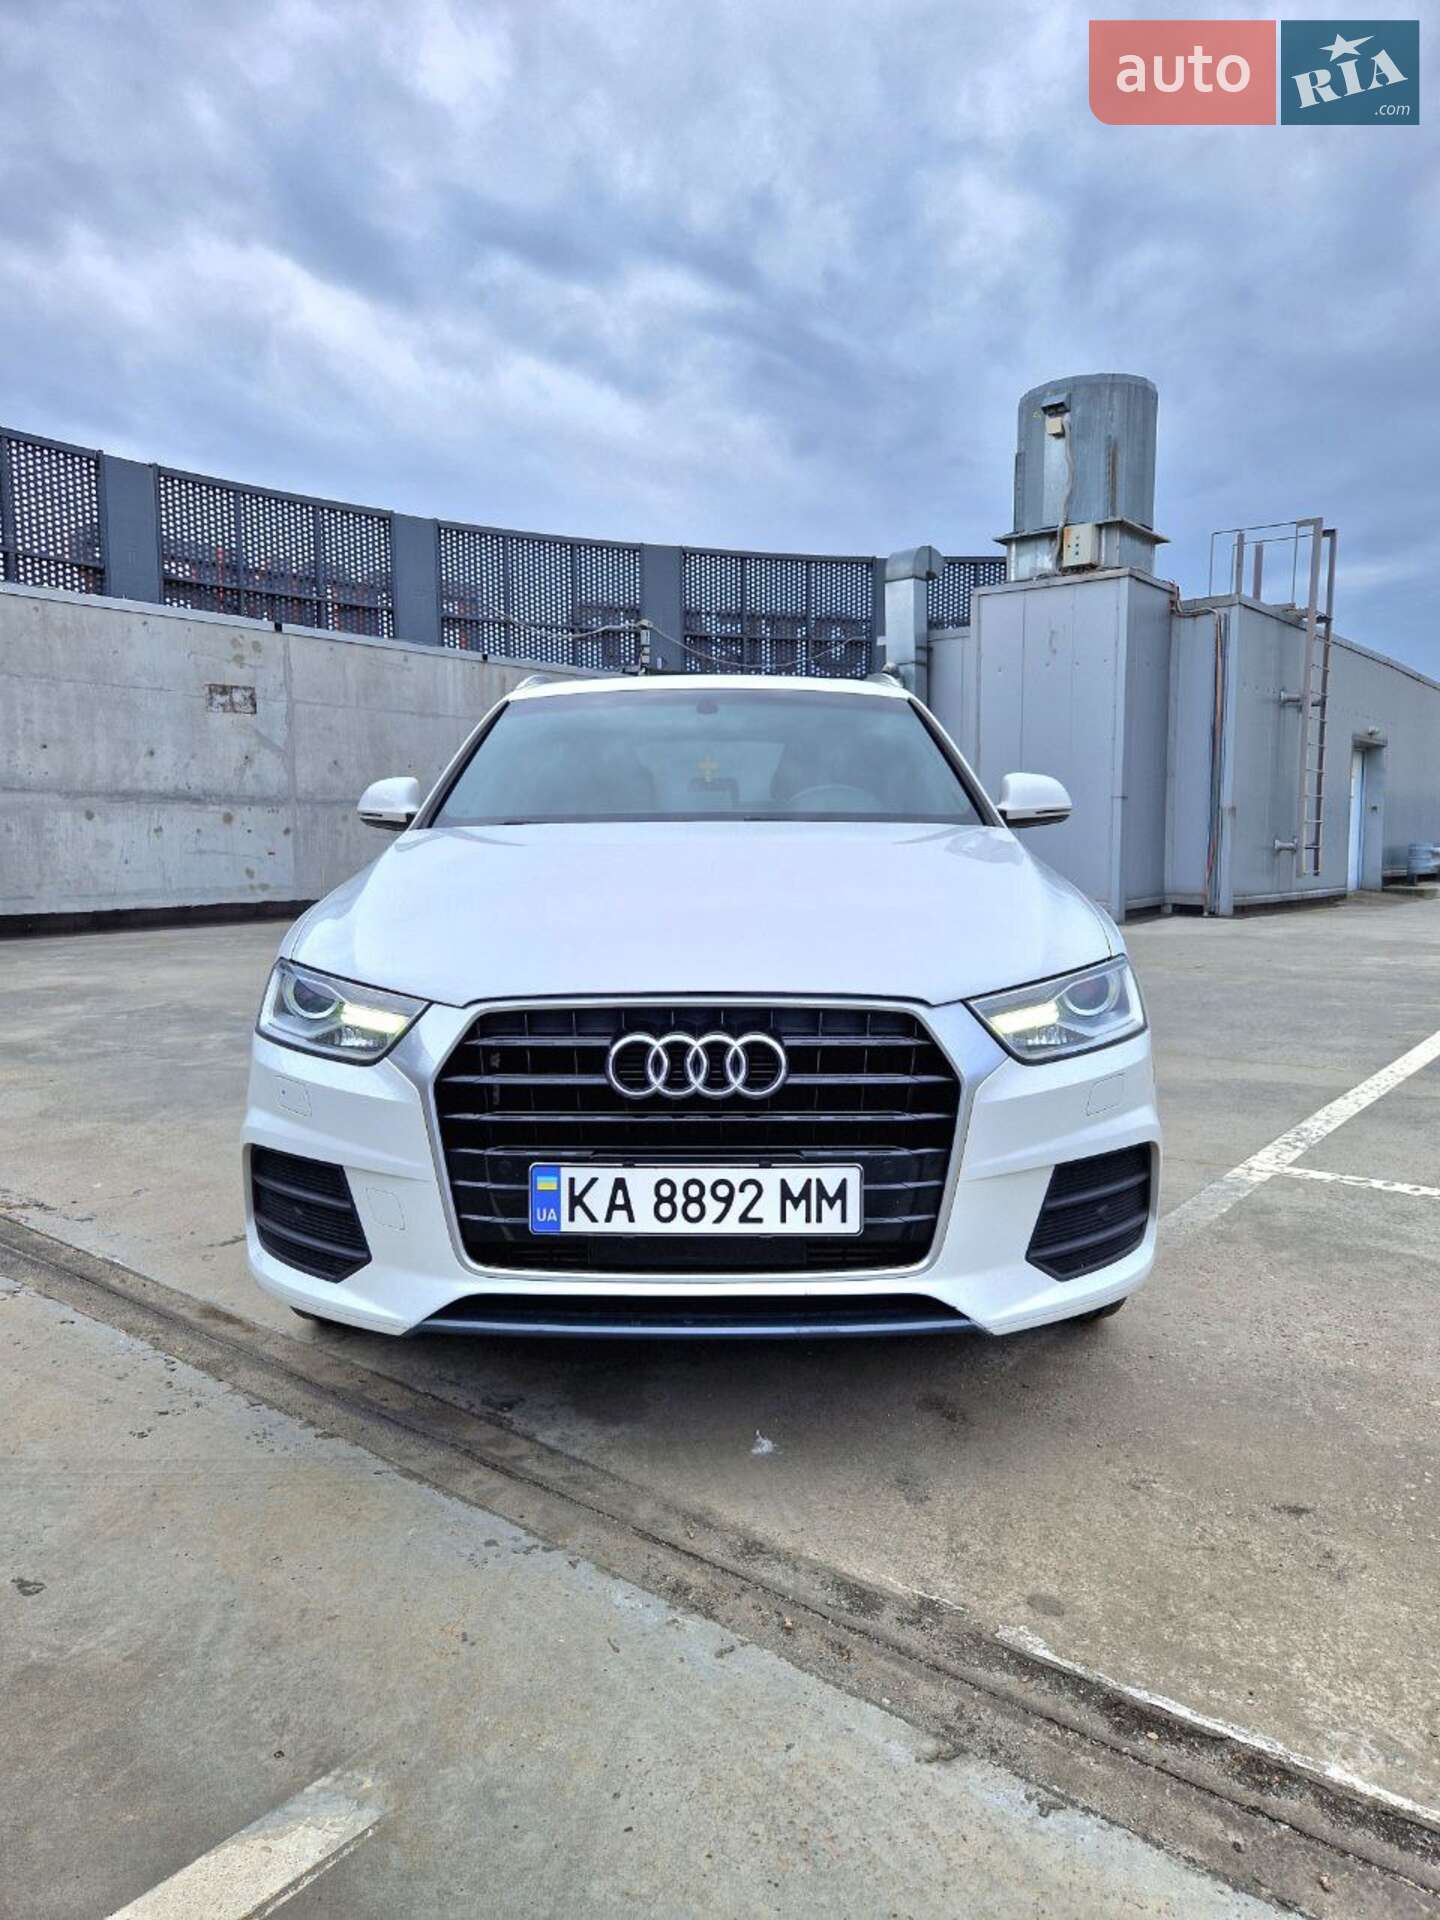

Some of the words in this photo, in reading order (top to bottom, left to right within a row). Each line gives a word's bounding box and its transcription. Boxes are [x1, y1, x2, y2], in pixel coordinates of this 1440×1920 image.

[536, 1207, 558, 1222] UA
[567, 1176, 636, 1223] KA
[653, 1177, 764, 1224] 8892
[779, 1177, 848, 1224] MM
